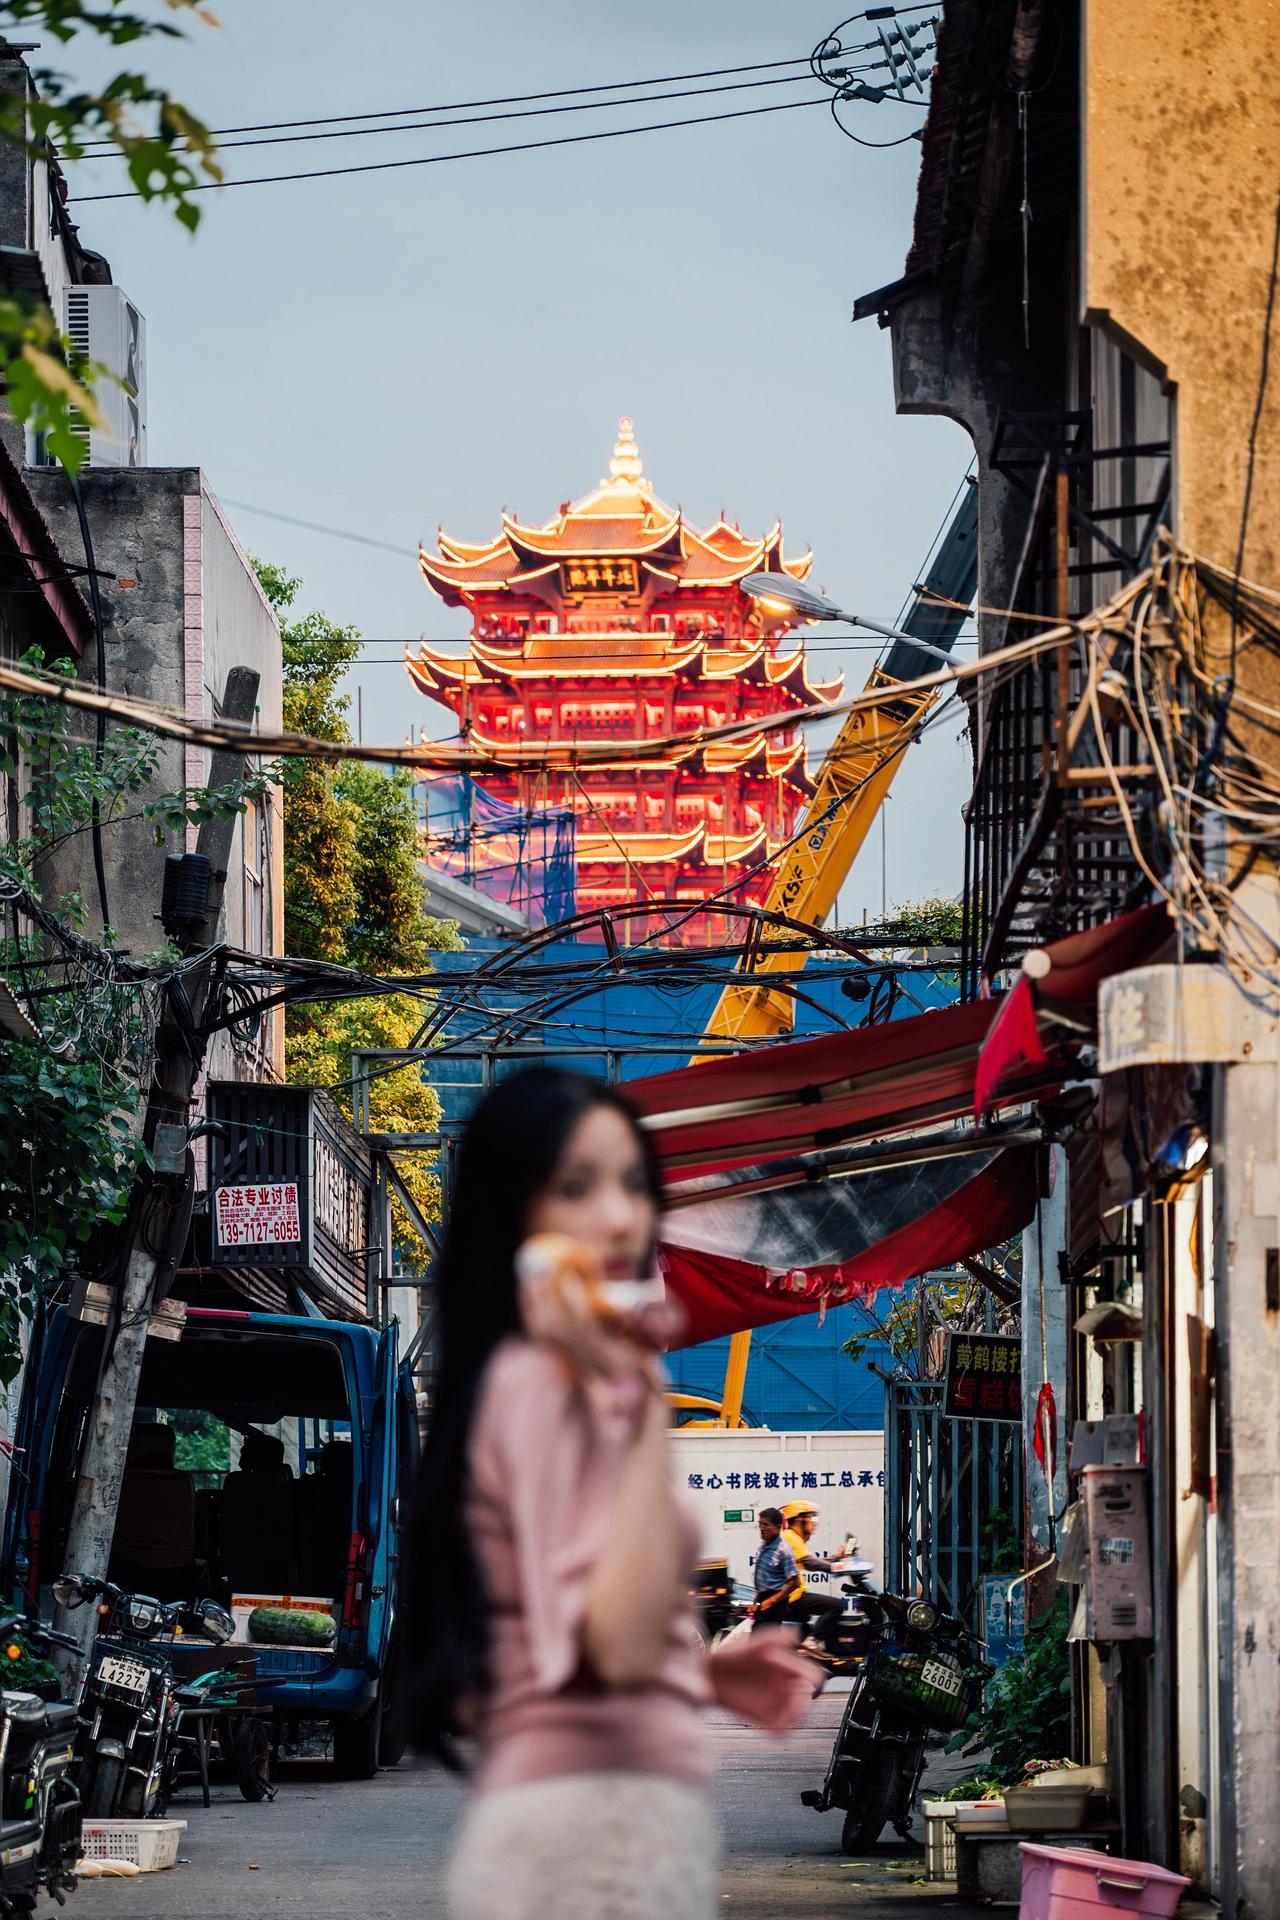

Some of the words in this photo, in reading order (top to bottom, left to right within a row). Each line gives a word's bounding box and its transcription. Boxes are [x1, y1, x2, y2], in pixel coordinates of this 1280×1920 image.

[218, 1185, 297, 1207] 合法专业讨债
[220, 1220, 299, 1243] 139-7127-6055
[803, 1573, 829, 1583] IGN
[99, 1666, 141, 1688] L4227
[923, 1668, 959, 1693] 26007
